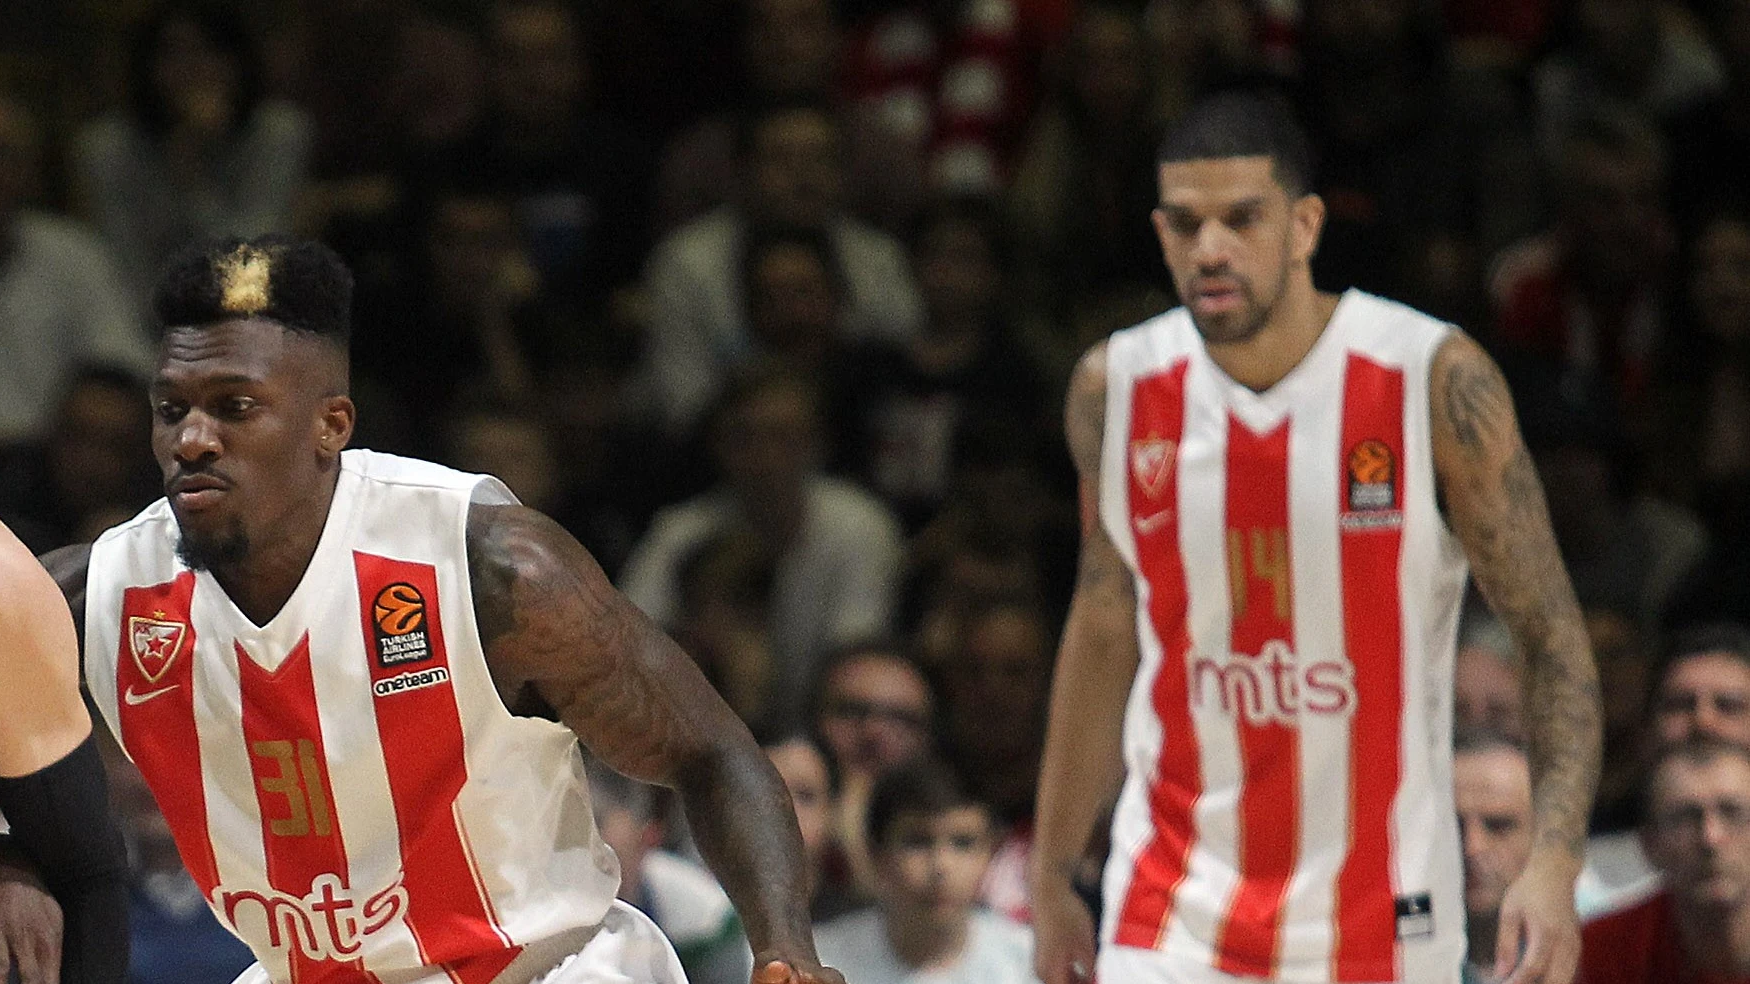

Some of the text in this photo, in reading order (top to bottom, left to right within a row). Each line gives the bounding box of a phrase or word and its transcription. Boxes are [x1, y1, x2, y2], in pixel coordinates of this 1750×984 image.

[1230, 526, 1292, 621] 14
[380, 631, 425, 647] TURKISH
[382, 640, 427, 655] AIRLINES
[1191, 648, 1351, 717] mts
[252, 738, 333, 839] 31
[221, 871, 406, 958] mts
